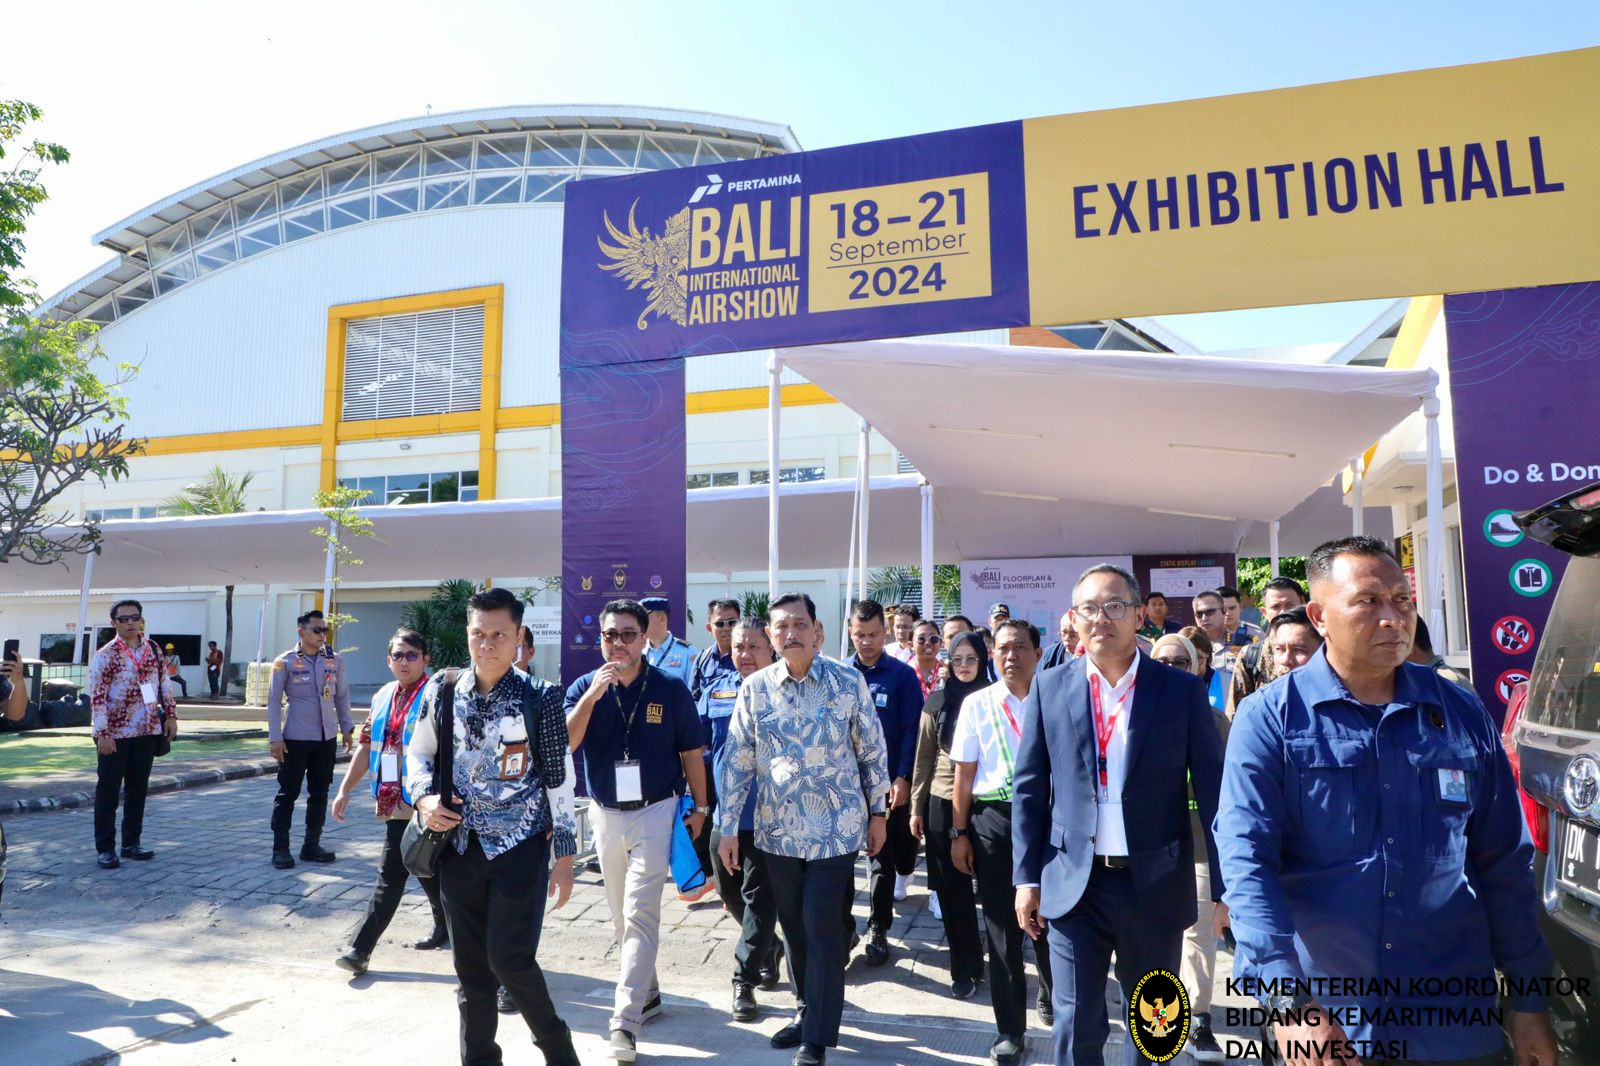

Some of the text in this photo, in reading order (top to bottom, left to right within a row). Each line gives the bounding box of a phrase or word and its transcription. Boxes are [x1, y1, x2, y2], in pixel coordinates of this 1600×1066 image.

[727, 173, 801, 193] PERTAMINA
[1073, 135, 1564, 239] EXHIBITION HALL
[690, 196, 802, 269] BALI
[829, 232, 966, 263] September
[689, 263, 800, 292] INTERNATIONAL
[848, 262, 947, 300] 2024
[688, 285, 799, 325] AIRSHOW
[1484, 466, 1520, 485] Do
[1526, 463, 1544, 483] &
[984, 571, 1001, 581] BALI
[646, 706, 663, 716] BALI
[1567, 824, 1586, 863] DK
